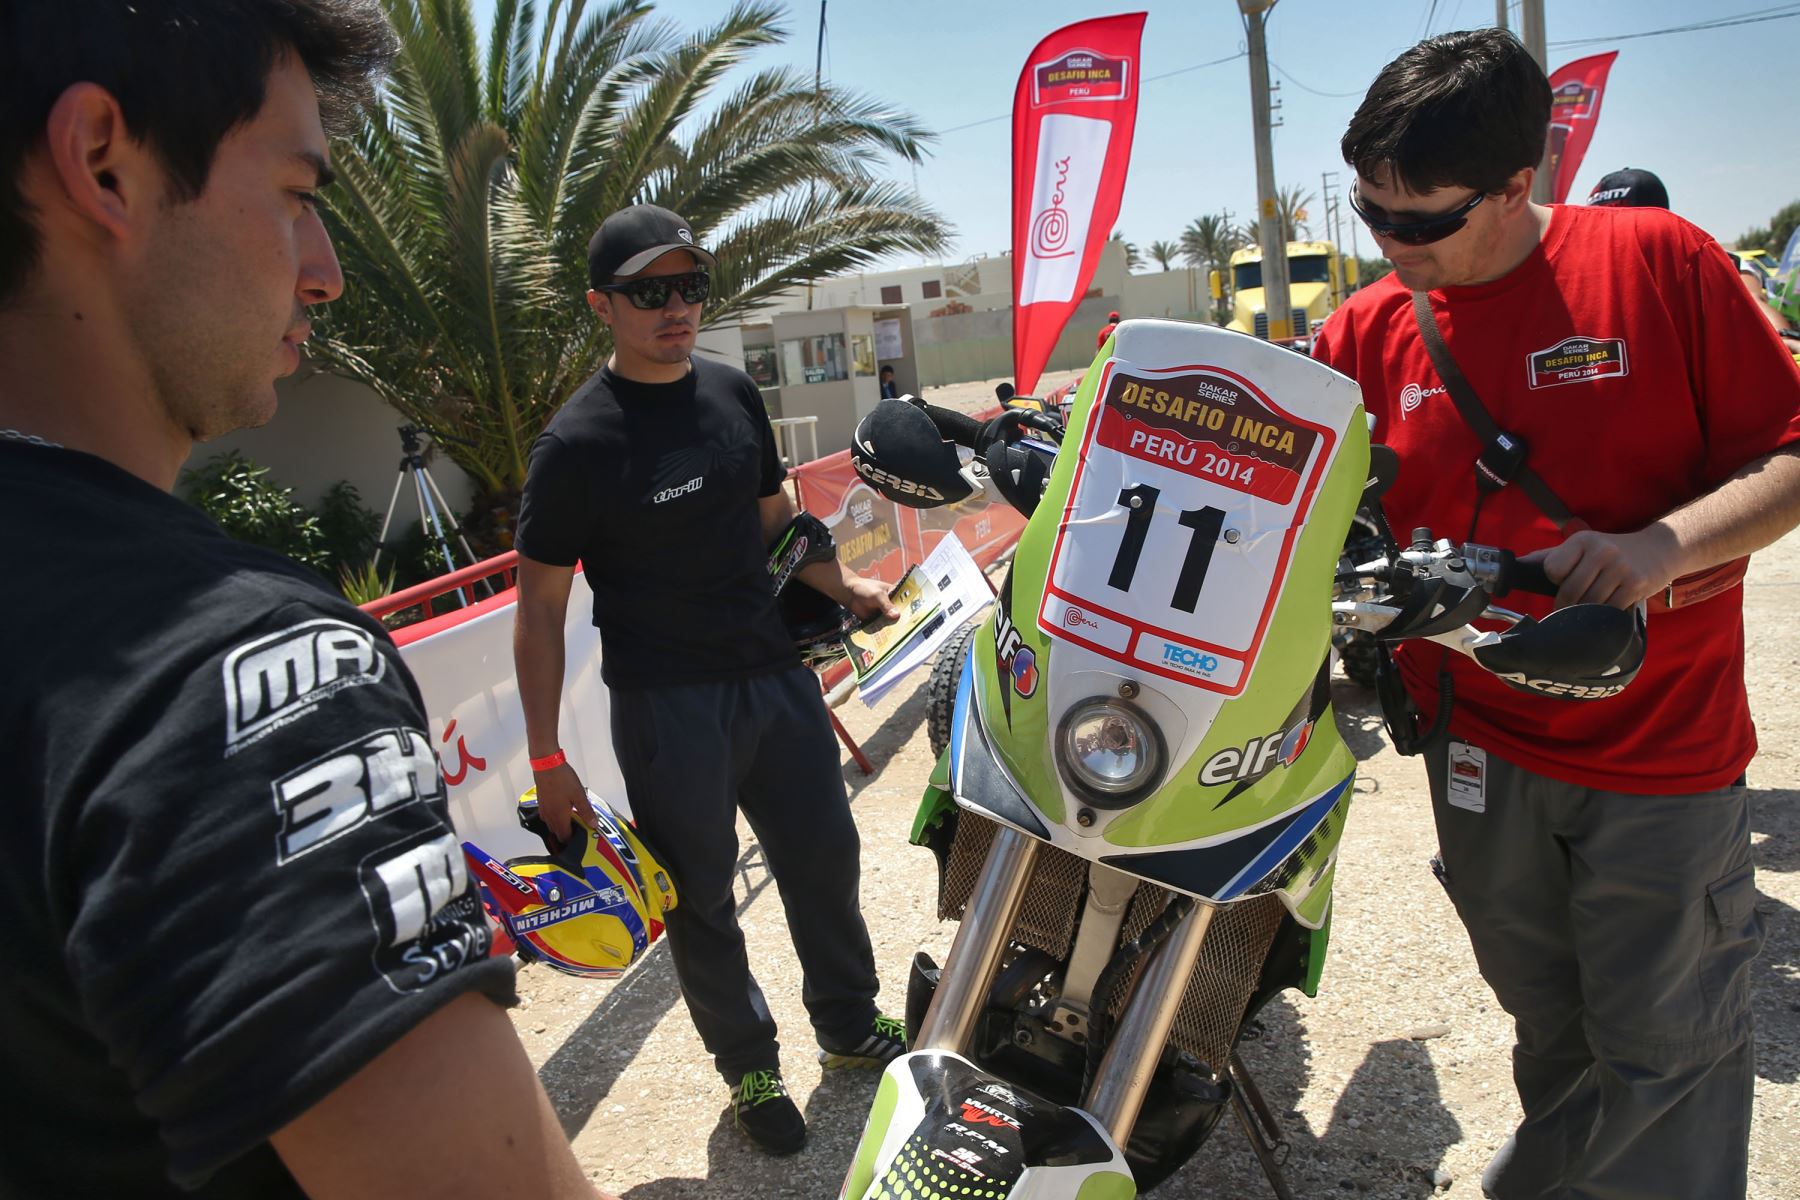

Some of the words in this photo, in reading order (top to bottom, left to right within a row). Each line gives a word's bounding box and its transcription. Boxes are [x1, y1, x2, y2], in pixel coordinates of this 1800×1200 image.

[1048, 70, 1085, 82] DESAFIO
[1088, 69, 1111, 79] INCA
[1545, 355, 1584, 367] DESAFIO
[1586, 351, 1608, 361] INCA
[1582, 368, 1598, 376] 2014
[1197, 389, 1236, 406] SERIES
[1199, 381, 1239, 399] DAKAR
[1121, 381, 1226, 432] DESAFIO
[1231, 415, 1296, 455] INCA
[1129, 429, 1197, 466] PERÚ
[1200, 453, 1255, 485] 2014
[653, 476, 703, 503] thrill
[840, 530, 873, 565] DESAFIO
[1107, 483, 1227, 614] 11
[1063, 606, 1099, 630] Perú
[1163, 643, 1218, 672] TECHO
[1169, 661, 1184, 670] TECHO
[1199, 731, 1285, 786] elf
[516, 898, 595, 931] MICHELIN
[402, 920, 486, 983] Style
[964, 1097, 1024, 1130] WIRTZ
[944, 1122, 1010, 1154] RPM
